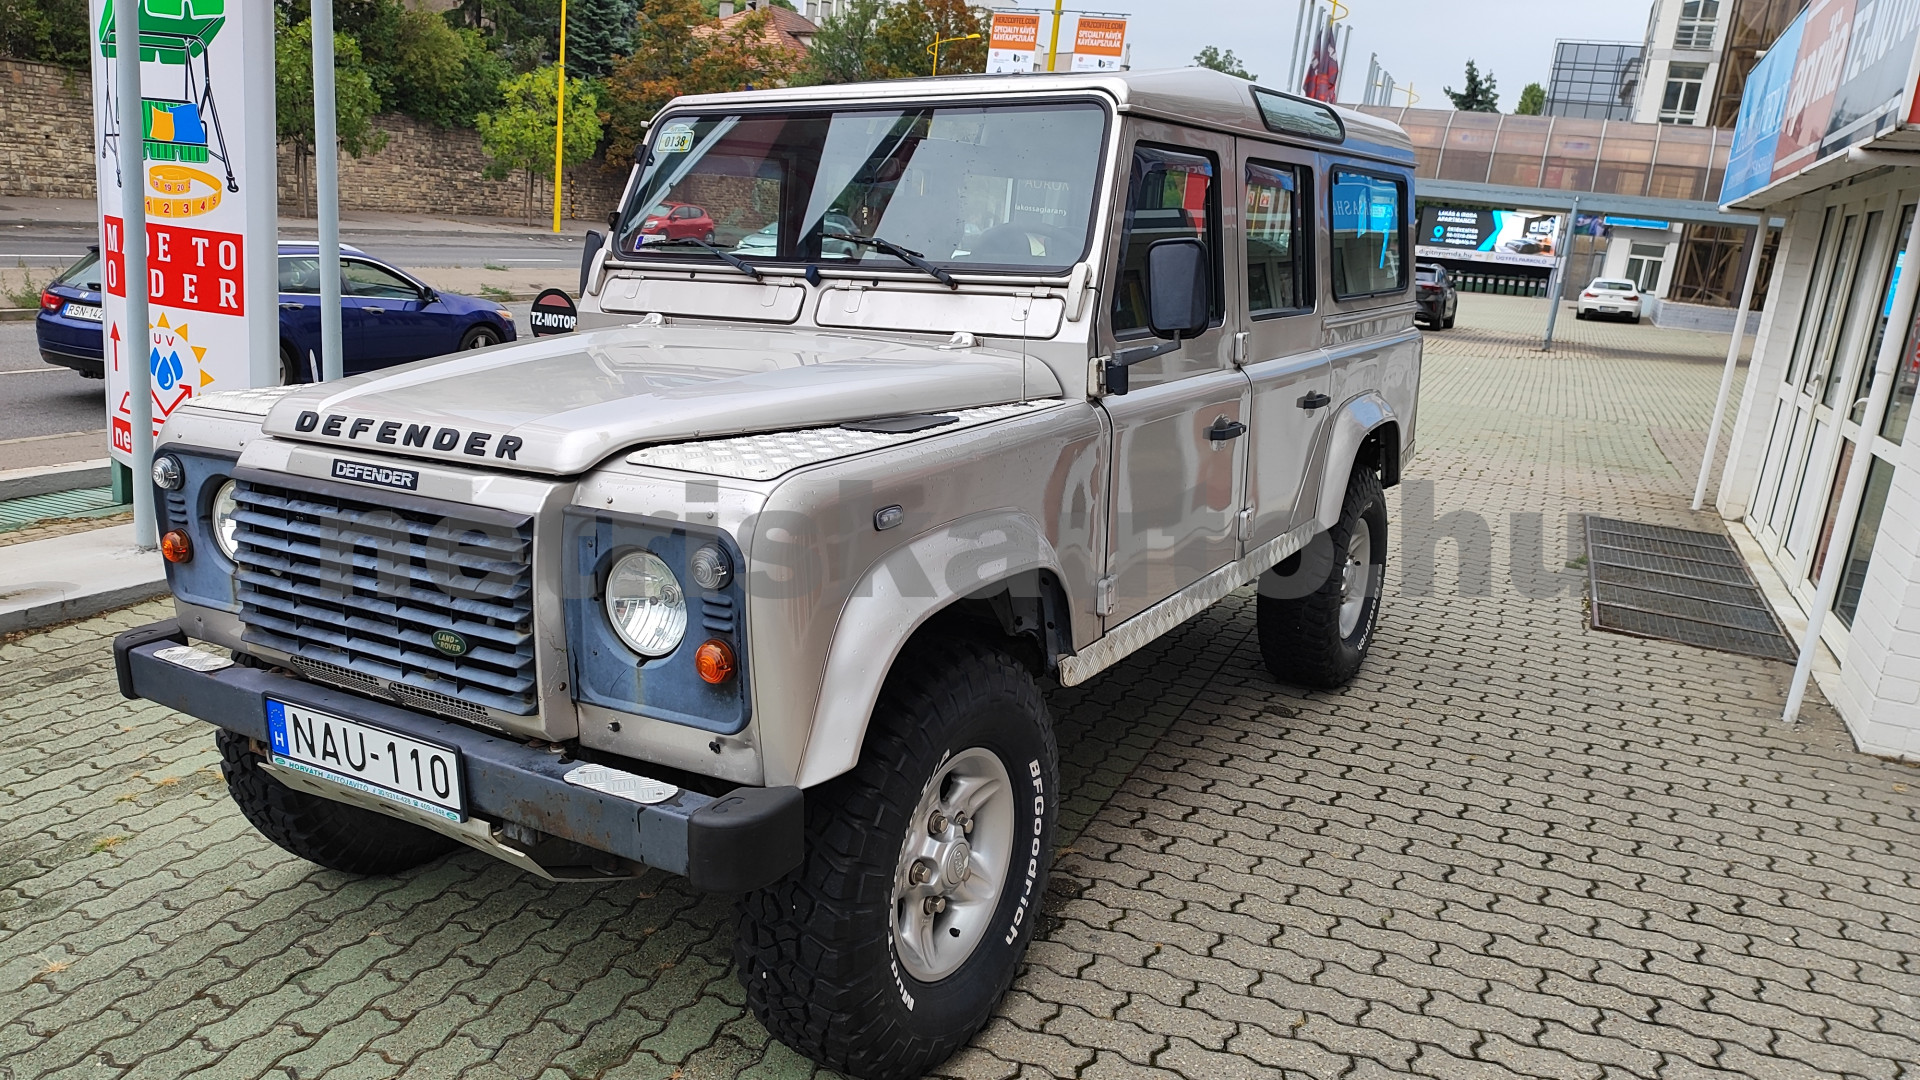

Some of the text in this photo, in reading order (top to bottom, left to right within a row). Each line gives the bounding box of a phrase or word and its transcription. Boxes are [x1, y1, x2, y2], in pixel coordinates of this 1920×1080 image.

[994, 25, 1019, 34] SPECIALTY
[995, 16, 1037, 25] HERZCOFFEE.COM
[1079, 30, 1105, 39] SPECIALTY
[664, 136, 687, 147] 0138
[163, 203, 170, 213] 2
[183, 203, 189, 213] 3
[191, 236, 237, 271] TO
[107, 259, 239, 309] ODER
[530, 311, 577, 329] TZ-MOTOR
[294, 410, 523, 461] DEFENDER
[335, 461, 415, 488] DEFENDER
[438, 633, 455, 643] LAND
[440, 641, 461, 652] ROVER
[274, 730, 285, 748] H
[291, 713, 450, 800] NAU-110
[1005, 759, 1044, 946] BFGoodrich
